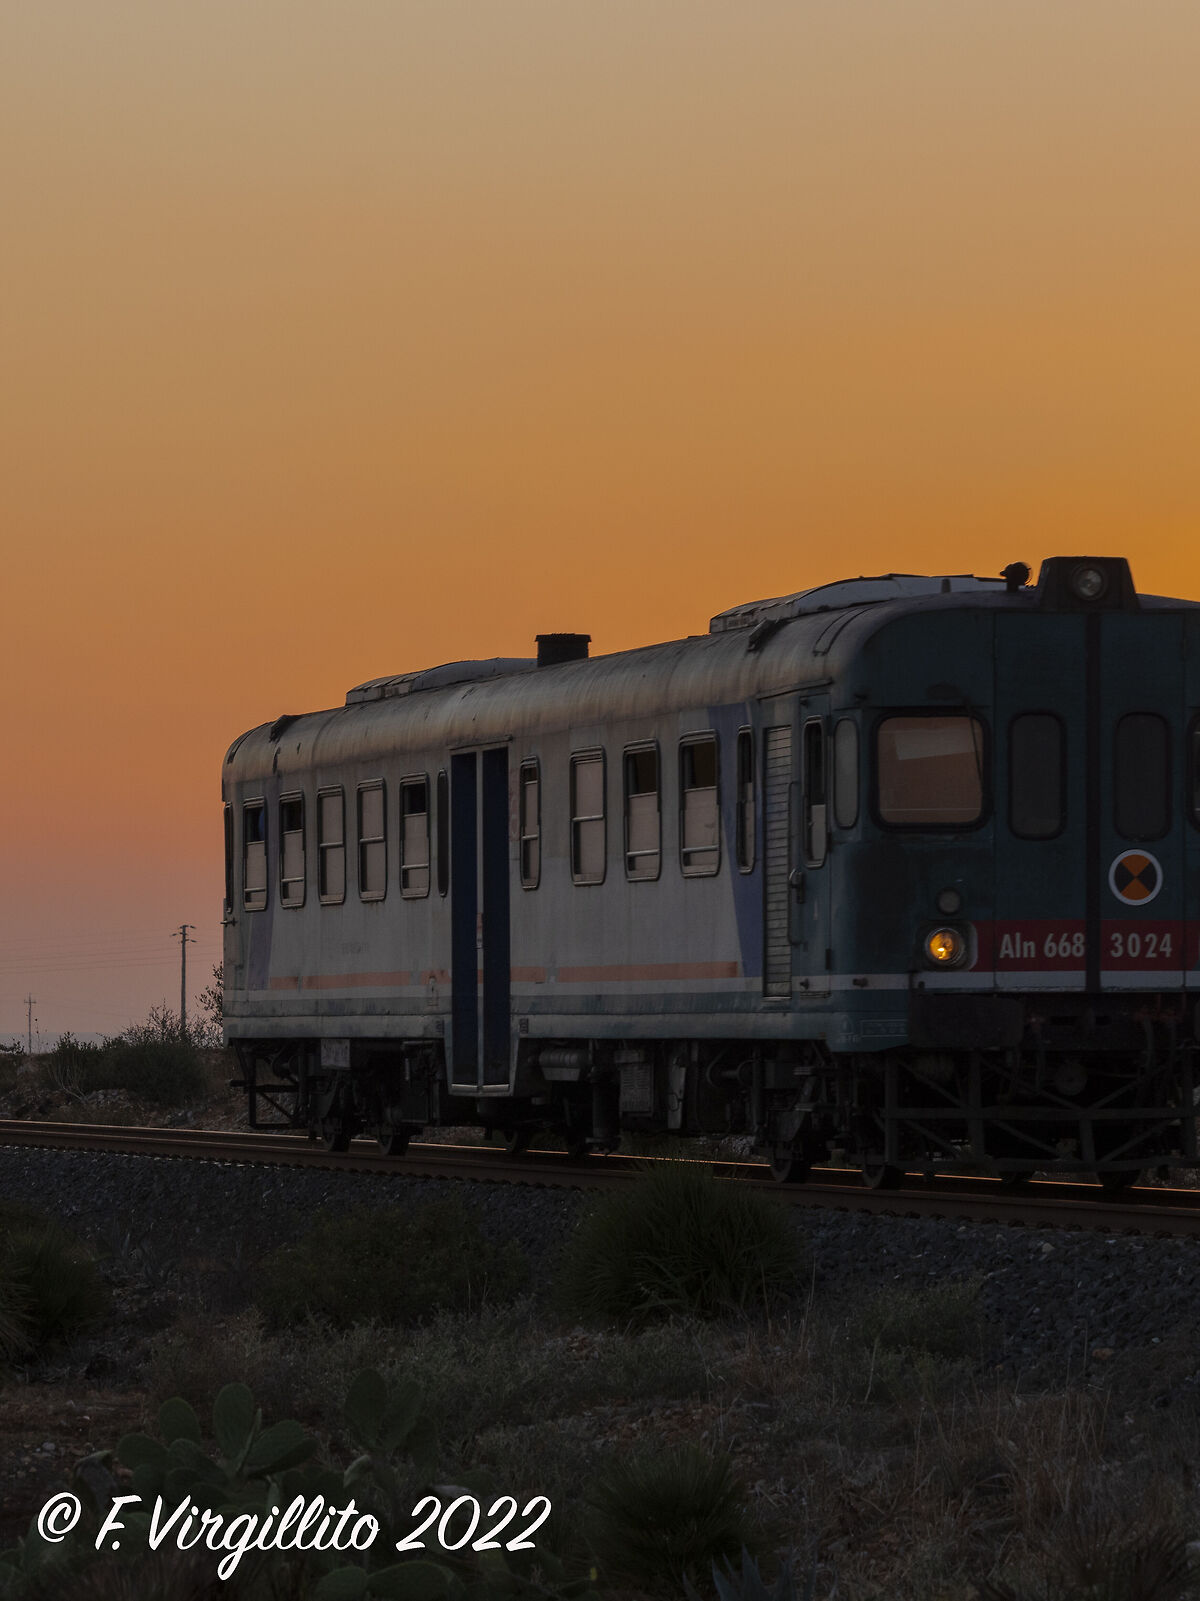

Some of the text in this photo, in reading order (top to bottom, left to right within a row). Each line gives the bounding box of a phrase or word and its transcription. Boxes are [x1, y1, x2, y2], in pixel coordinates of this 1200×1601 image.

[1000, 932, 1173, 959] Aln 668 3024
